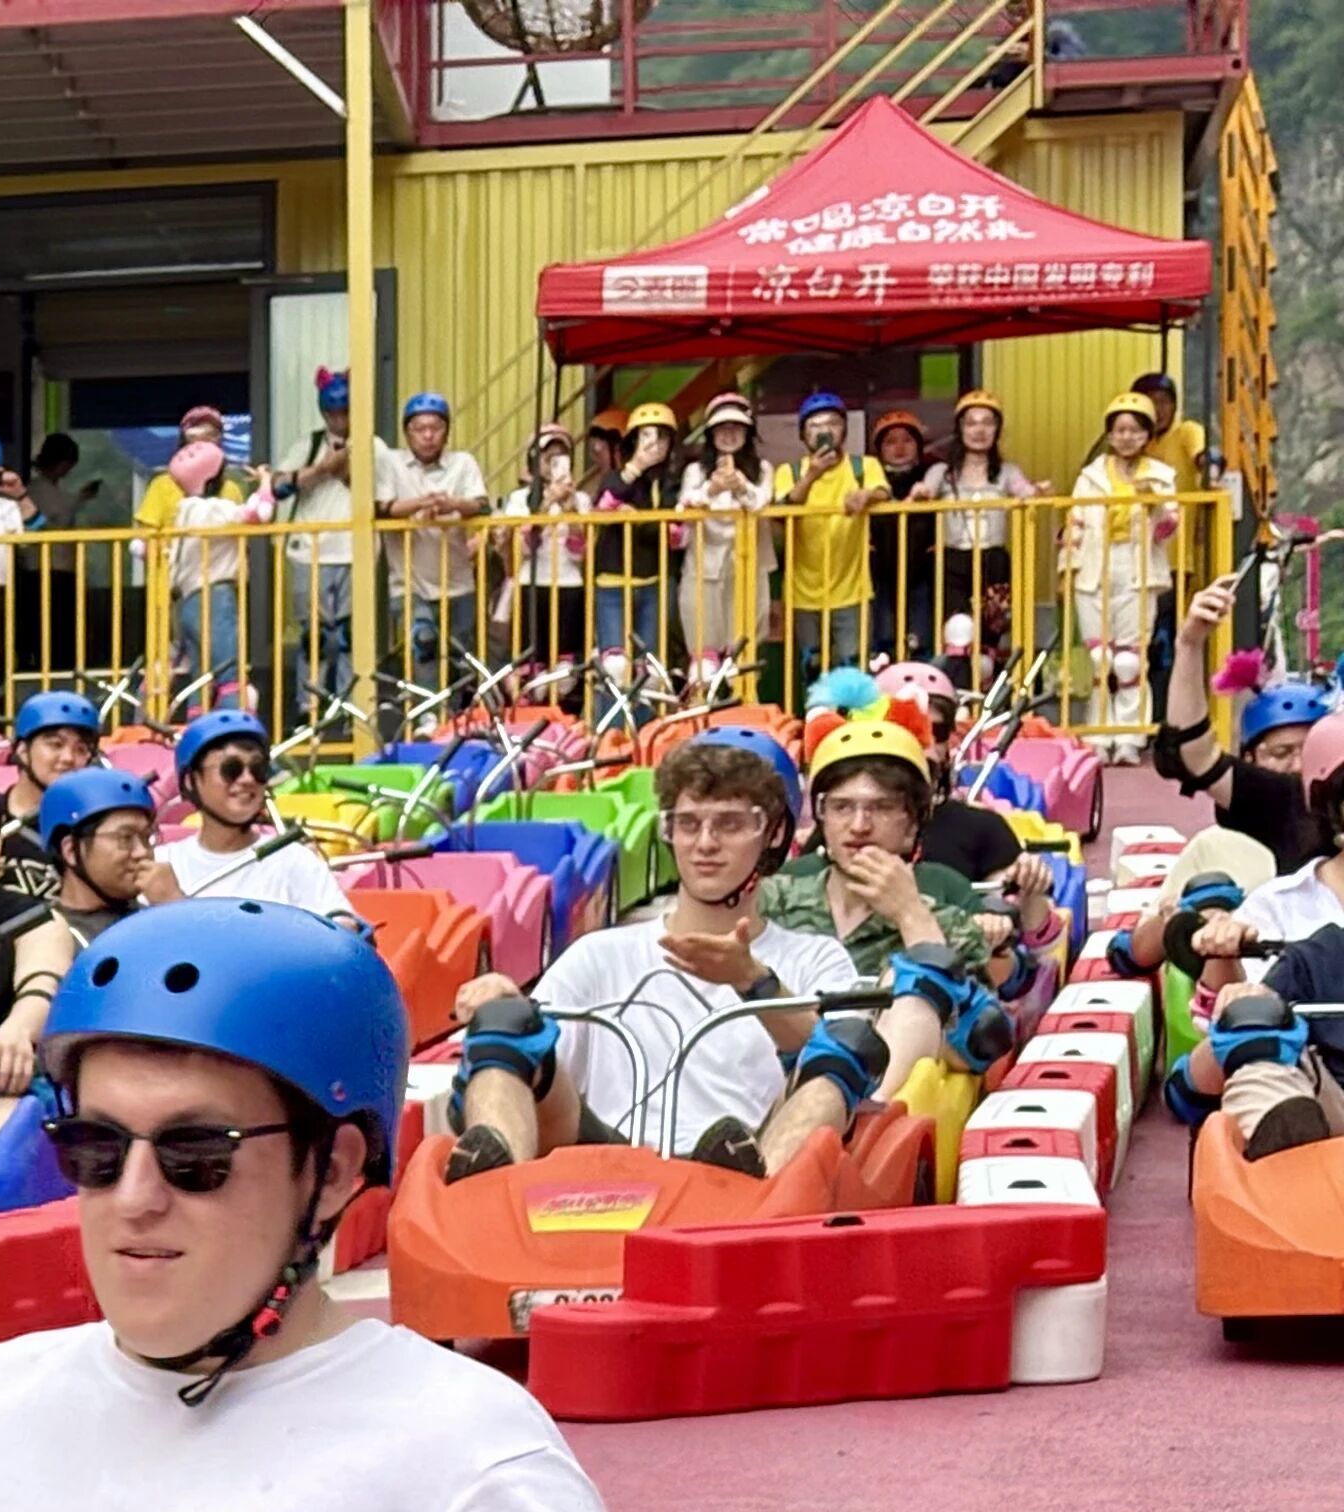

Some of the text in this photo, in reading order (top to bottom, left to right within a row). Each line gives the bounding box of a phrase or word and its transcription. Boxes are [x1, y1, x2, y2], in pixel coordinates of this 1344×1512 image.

[738, 192, 1006, 245] 常喝凉白开
[784, 219, 1036, 256] 健康自然来
[752, 263, 899, 306] 凉白开
